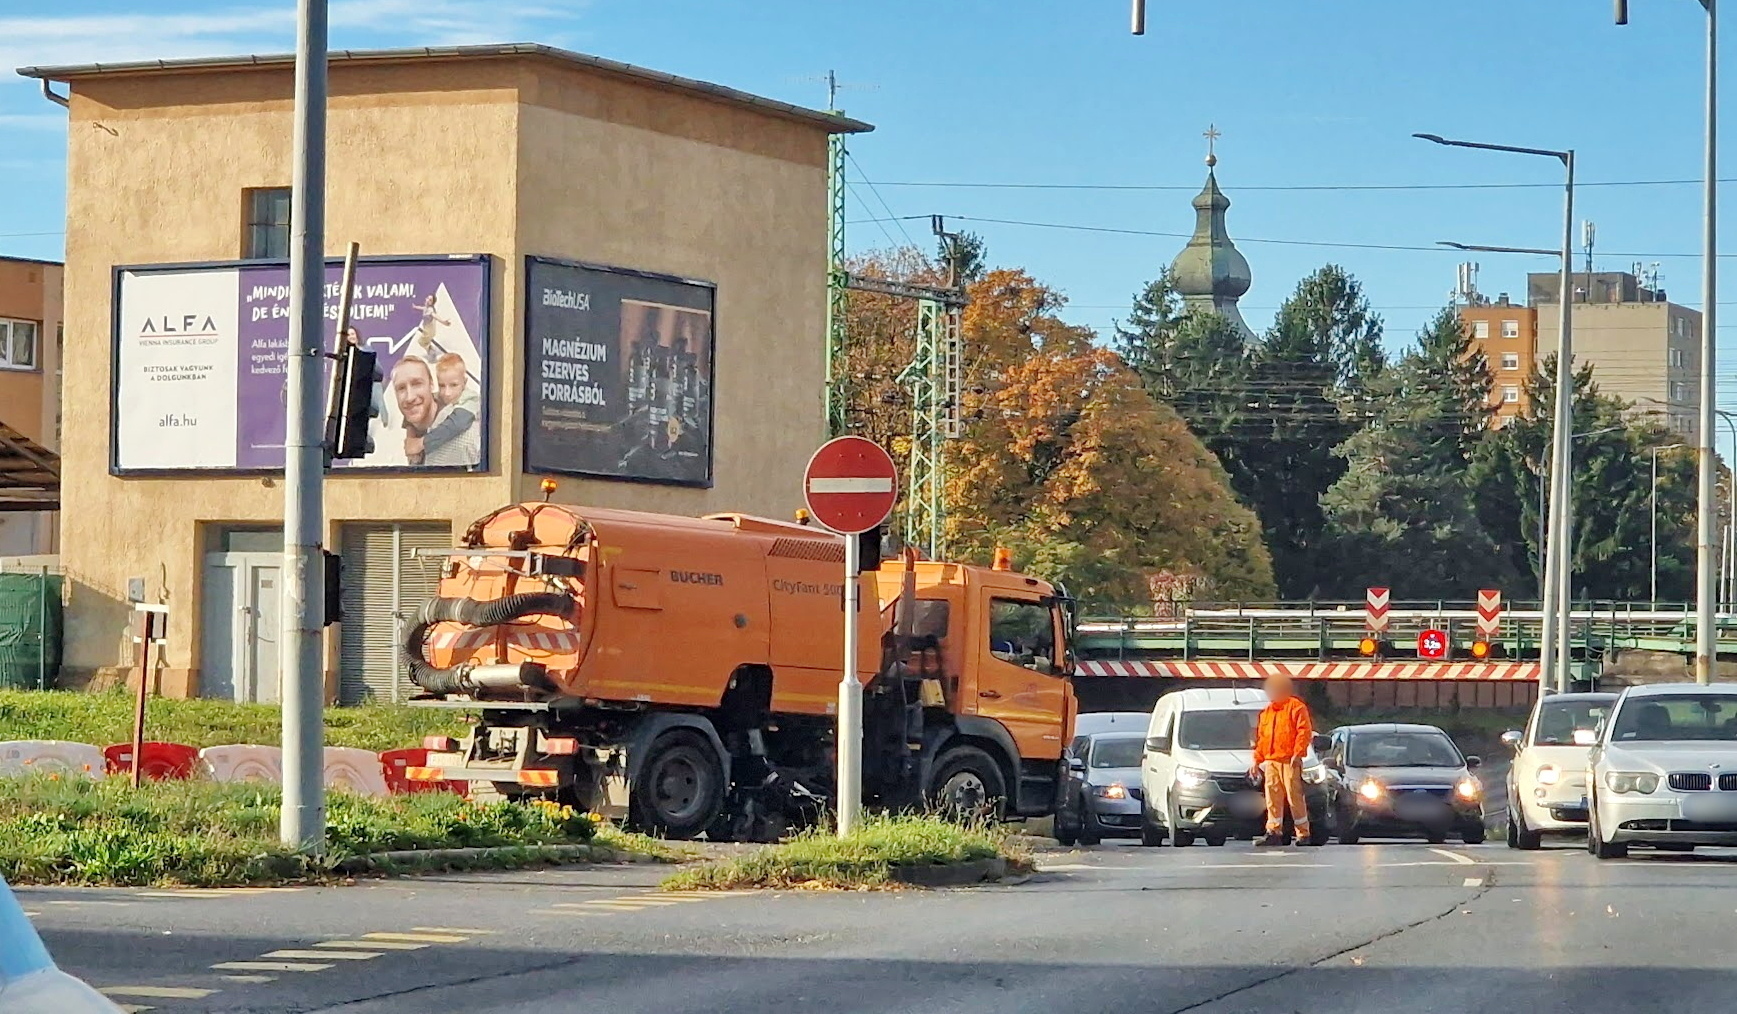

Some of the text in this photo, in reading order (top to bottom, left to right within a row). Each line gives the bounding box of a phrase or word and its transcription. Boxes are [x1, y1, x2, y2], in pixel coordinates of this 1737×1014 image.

[366, 283, 416, 299] VALAMI.
[542, 288, 590, 311] BioTechUSA
[252, 306, 268, 321] DE
[141, 315, 217, 333] ALFA
[251, 339, 267, 348] Alfa
[542, 336, 607, 363] MAGNÉZIUM
[251, 351, 276, 363] egyedi
[251, 364, 281, 374] kedvező
[541, 360, 590, 382] SZERVES
[541, 380, 606, 406] FORRÁSBÓL
[159, 413, 197, 427] alfa.hu
[670, 570, 724, 586] BUCHER
[773, 578, 820, 595] CityFant
